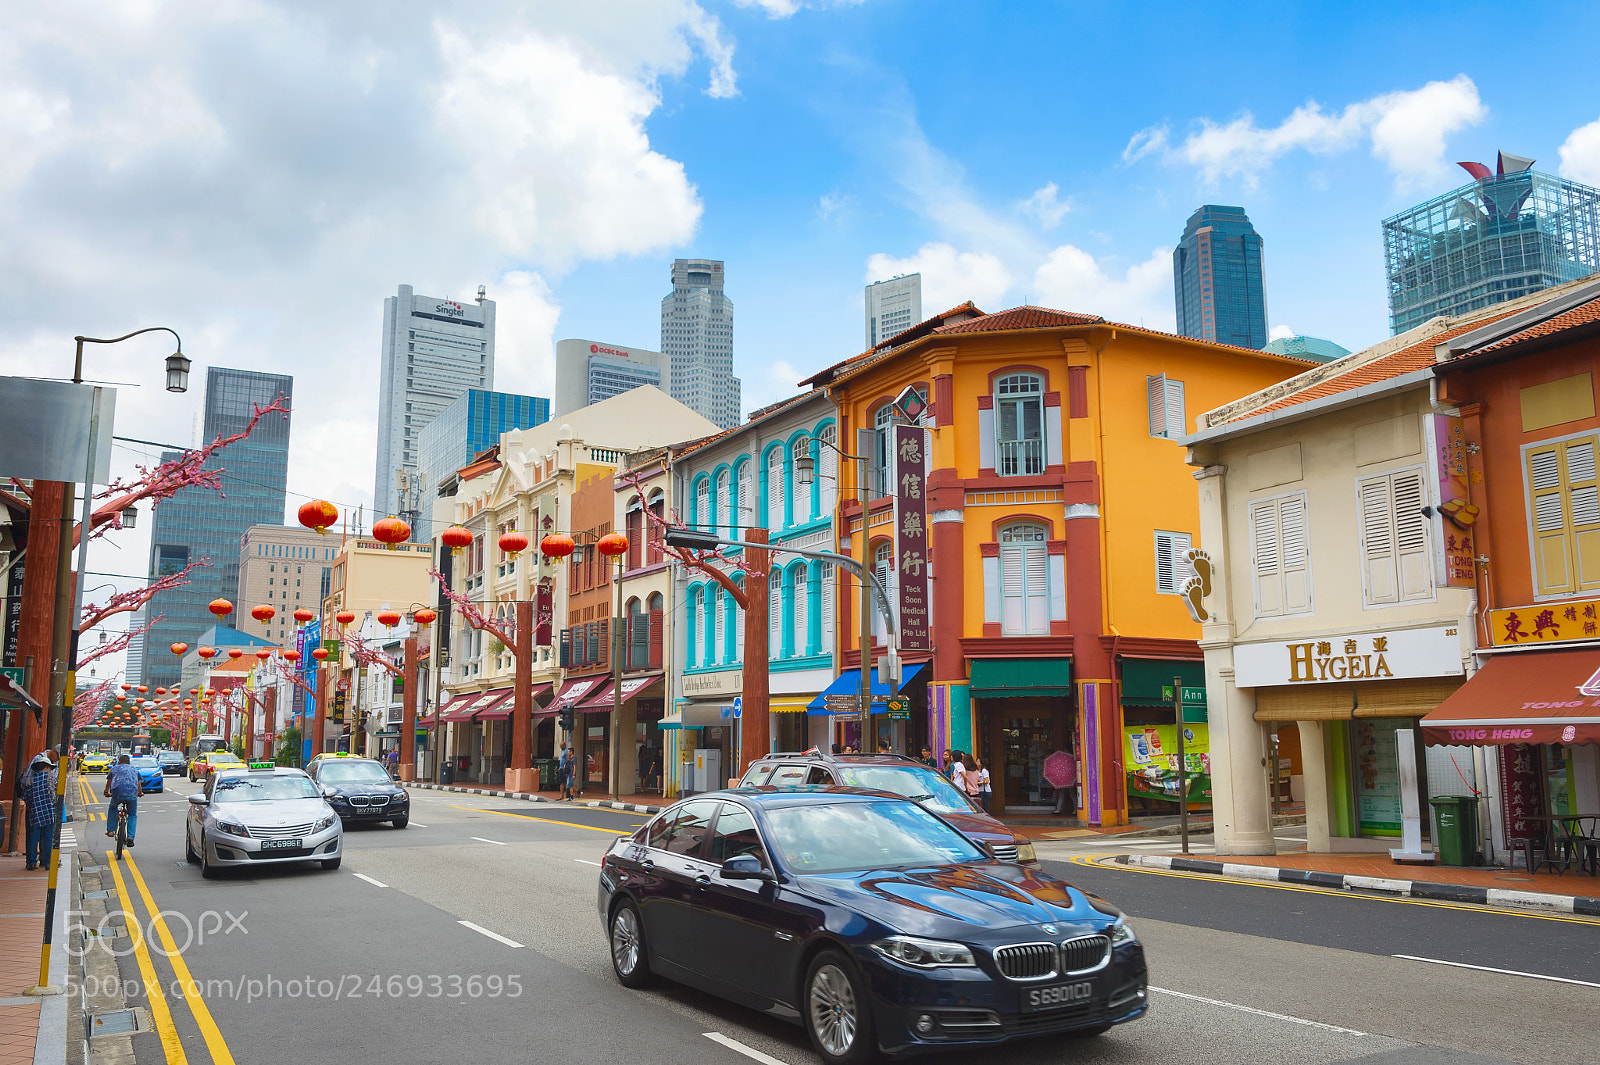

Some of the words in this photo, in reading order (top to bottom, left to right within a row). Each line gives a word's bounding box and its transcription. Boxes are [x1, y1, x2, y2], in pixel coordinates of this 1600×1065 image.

[435, 304, 464, 318] Singtel
[599, 347, 615, 355] OCBC
[615, 350, 629, 358] Bank
[1448, 554, 1473, 567] TONG
[1449, 568, 1474, 580] HENG
[905, 585, 921, 593] Teck
[905, 596, 921, 604] Soon
[901, 606, 926, 615] Medical
[908, 618, 920, 626] Hall
[1503, 609, 1560, 643] 東興
[902, 629, 914, 637] Pte
[915, 629, 926, 637] Ltd
[1445, 628, 1458, 637] 283
[1285, 642, 1394, 682] HYGEIA
[4, 670, 19, 683] St
[1184, 689, 1202, 700] Ann
[1520, 700, 1585, 710] TONG
[1448, 729, 1487, 741] TONG
[1492, 728, 1534, 740] HENG
